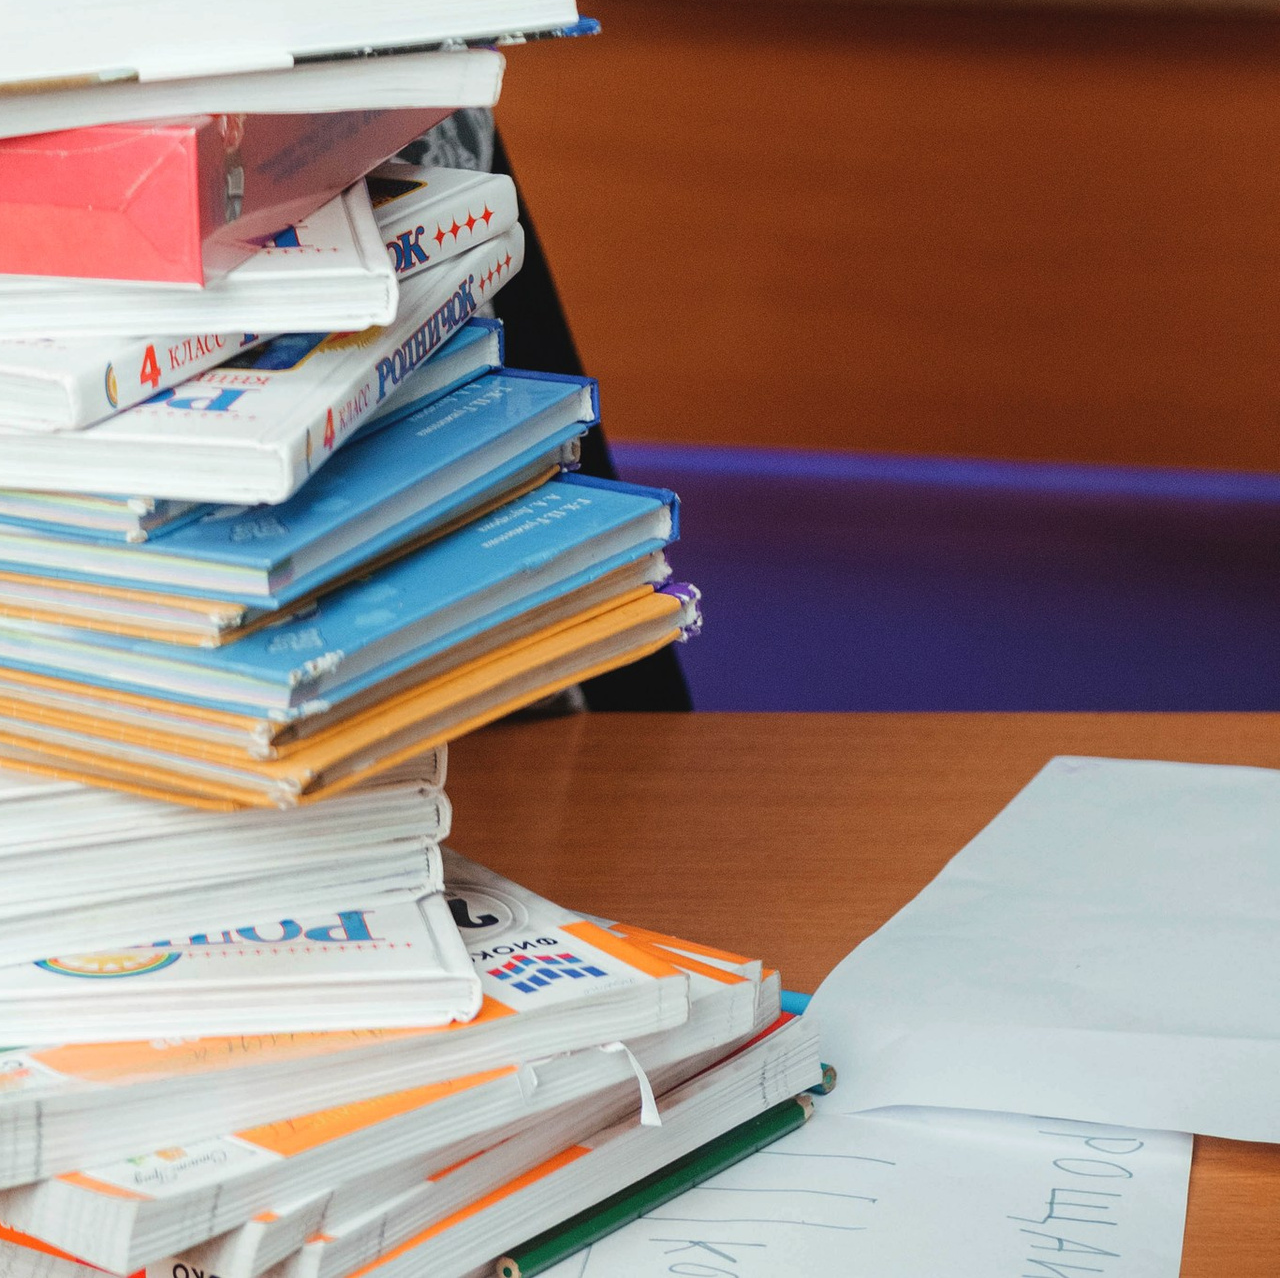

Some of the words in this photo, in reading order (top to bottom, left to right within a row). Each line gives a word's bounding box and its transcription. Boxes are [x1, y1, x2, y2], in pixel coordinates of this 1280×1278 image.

[140, 344, 162, 389] 4
[323, 408, 336, 450] 4
[338, 384, 372, 431] КЛАСС
[375, 273, 478, 404] РОДНИЧОК
[472, 936, 559, 964] ФИОК
